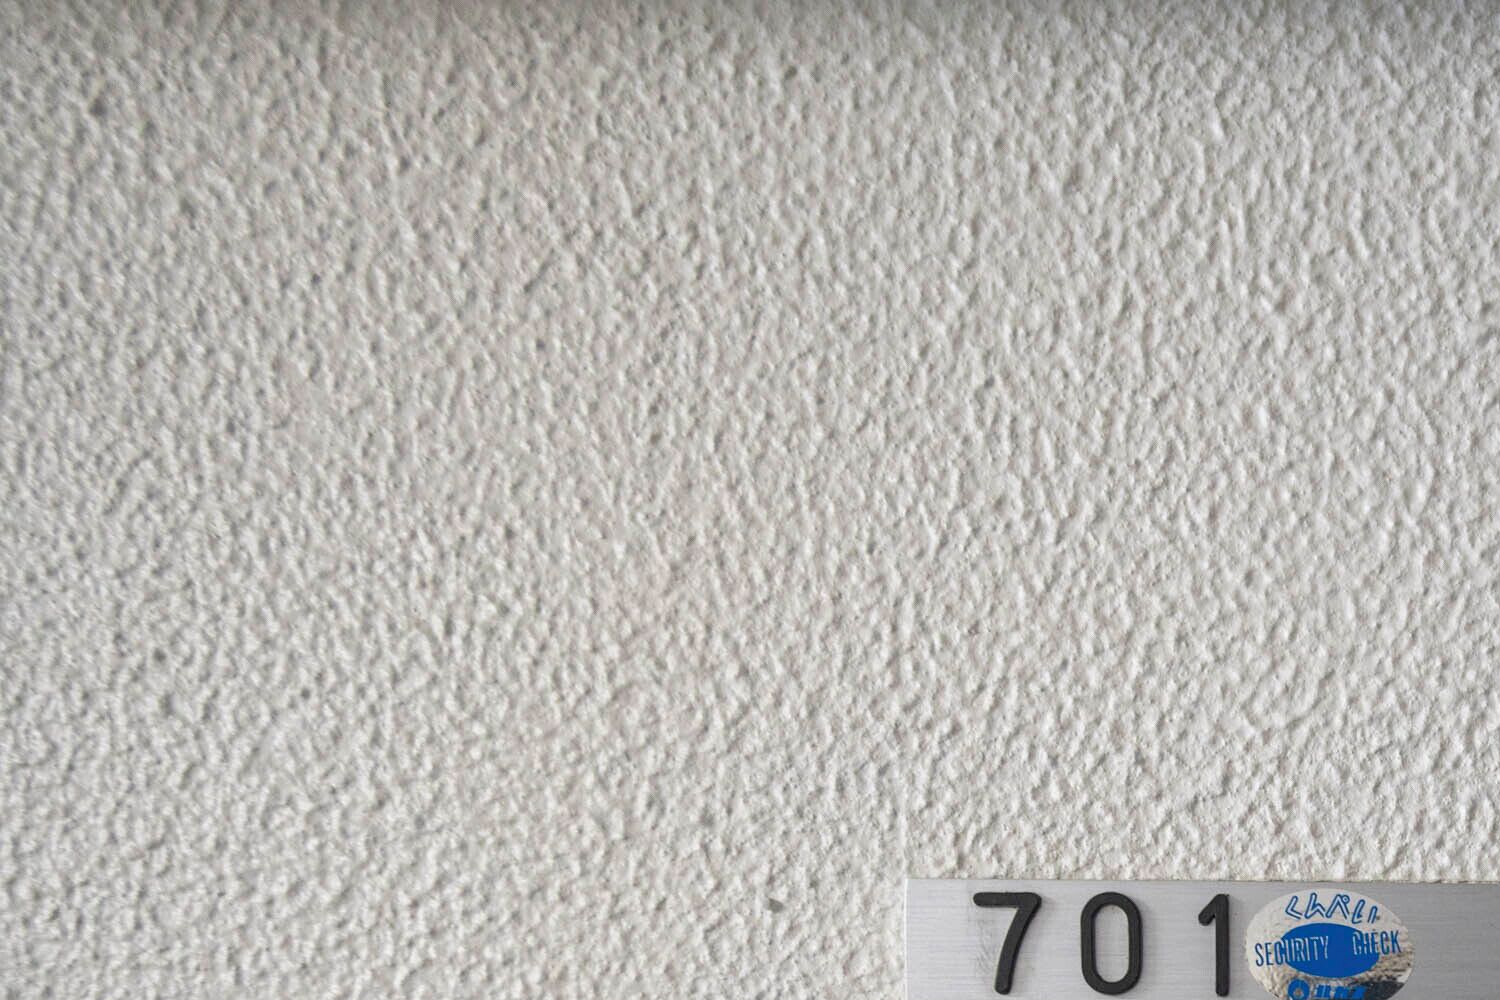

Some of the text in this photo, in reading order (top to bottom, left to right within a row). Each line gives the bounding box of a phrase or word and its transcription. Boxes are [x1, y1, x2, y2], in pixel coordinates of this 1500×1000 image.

[973, 891, 1230, 997] 701
[1255, 930, 1401, 967] SECURITY CHECK
